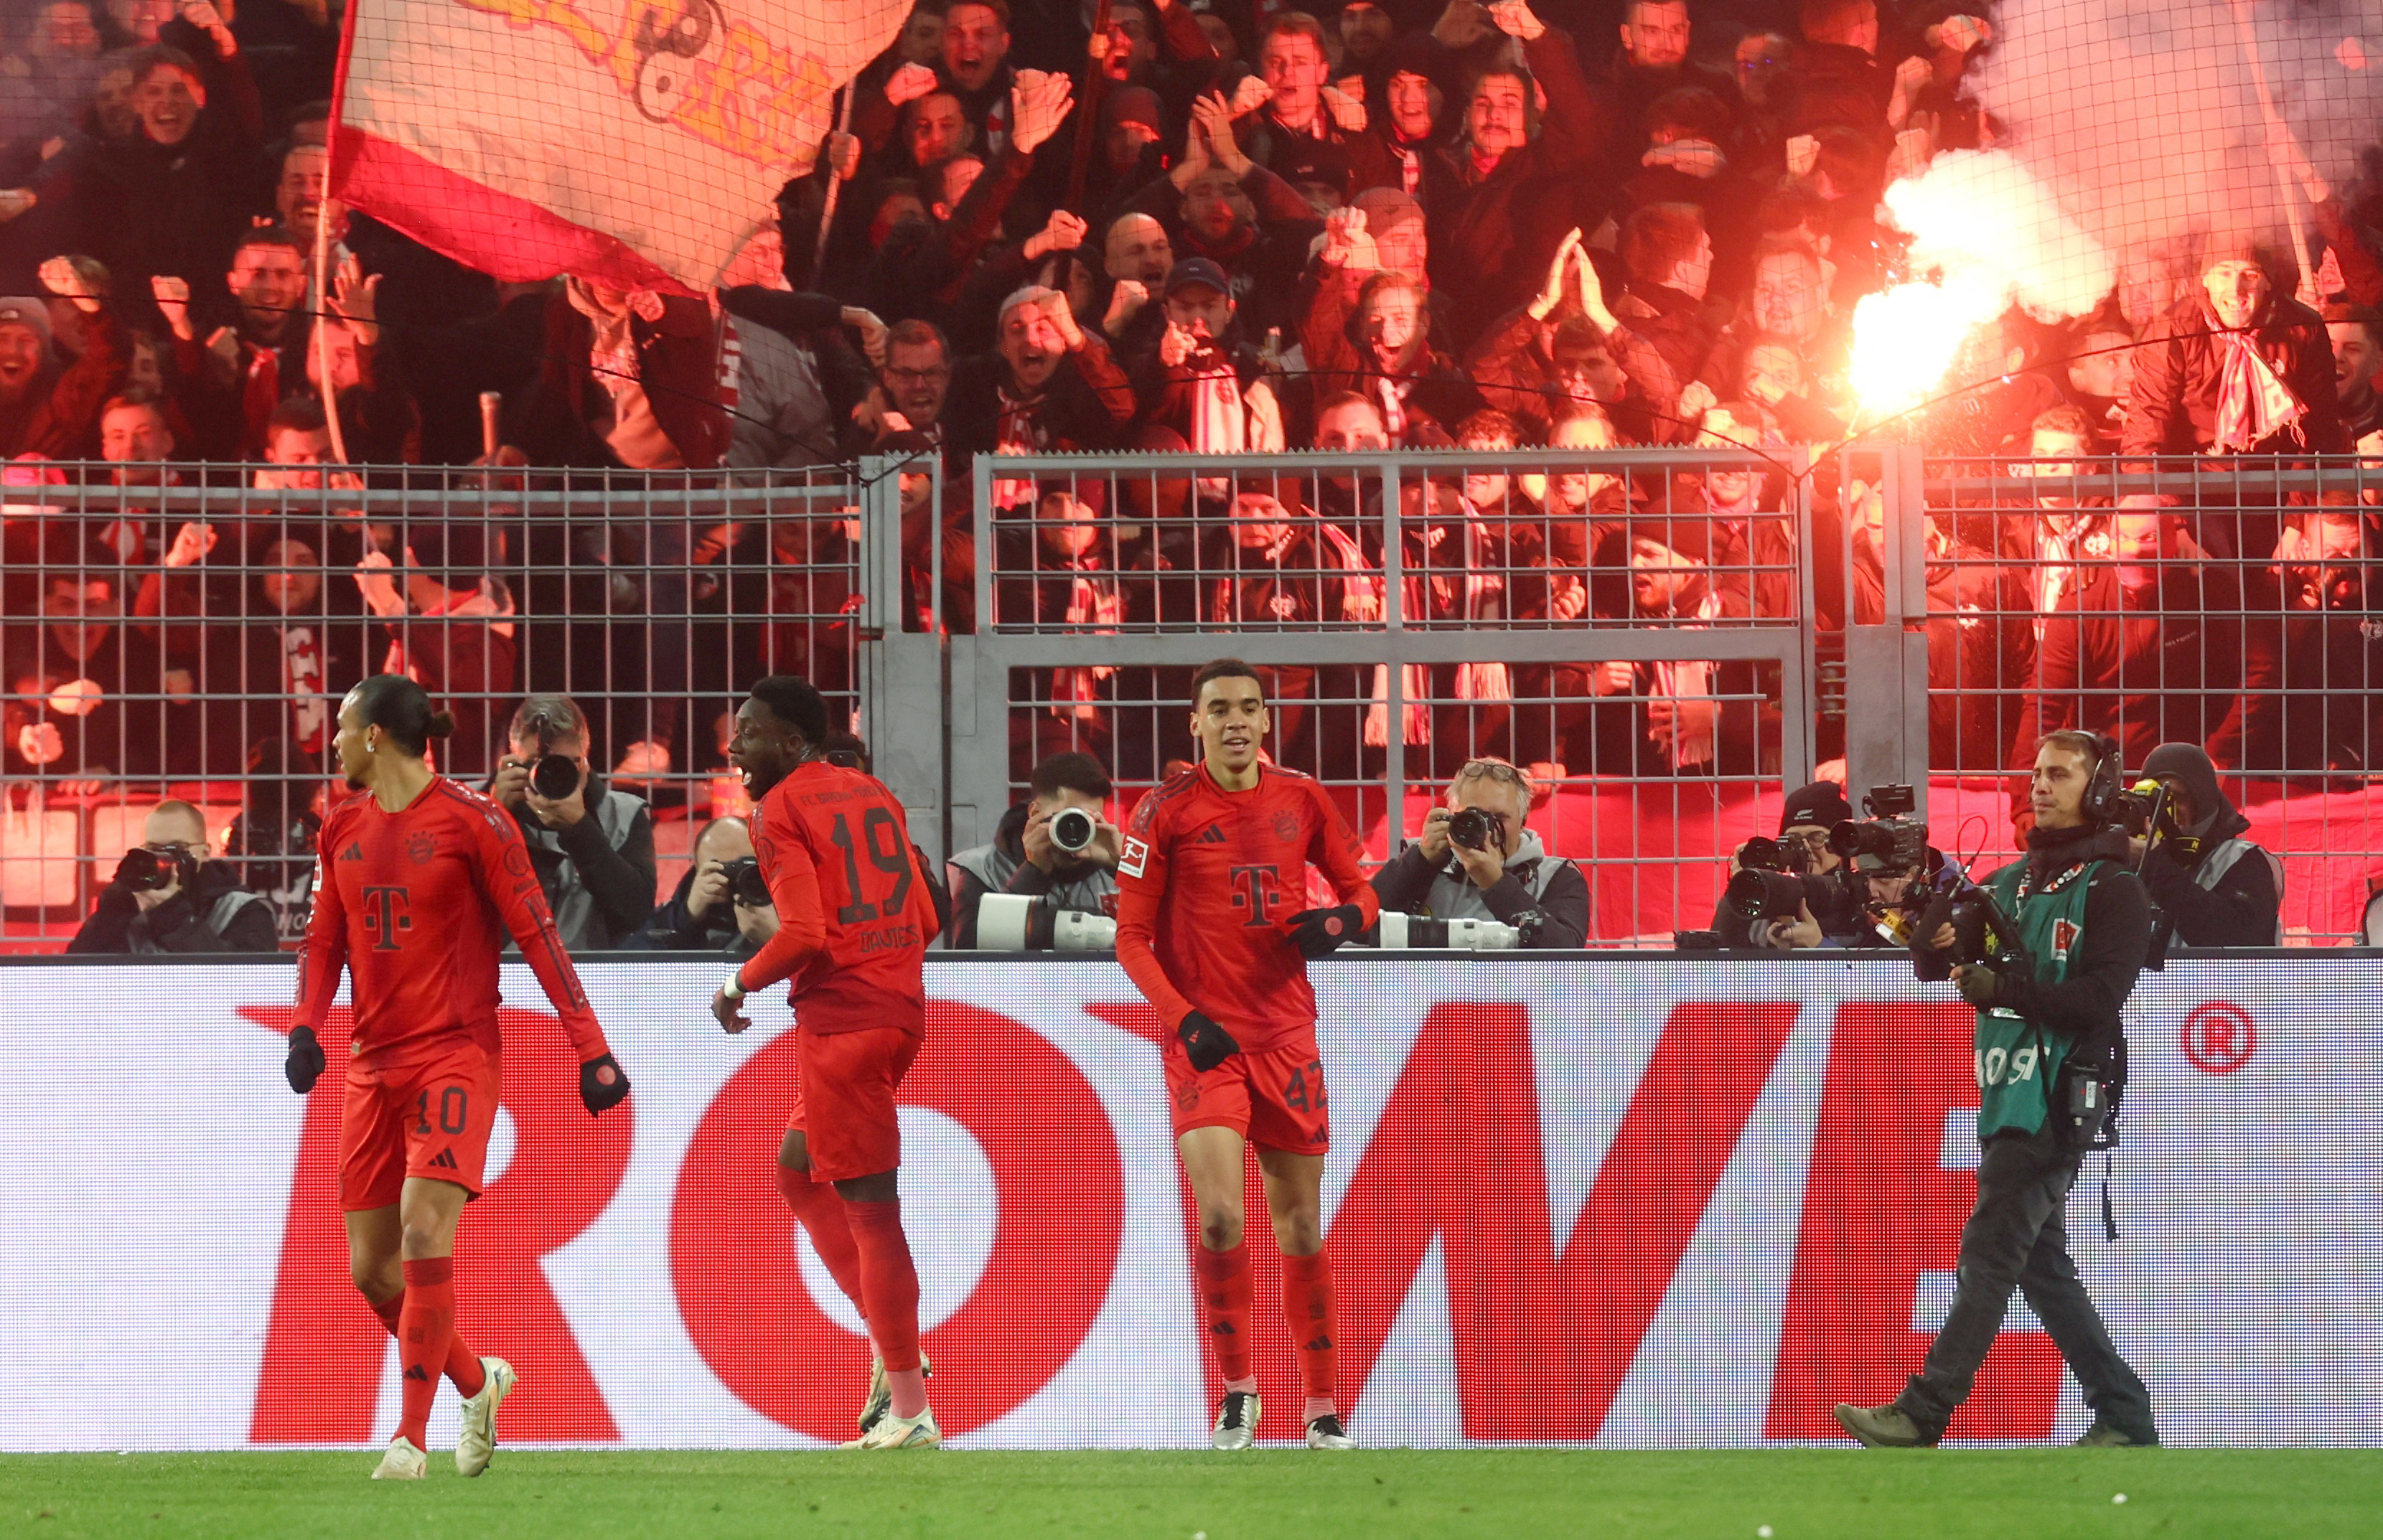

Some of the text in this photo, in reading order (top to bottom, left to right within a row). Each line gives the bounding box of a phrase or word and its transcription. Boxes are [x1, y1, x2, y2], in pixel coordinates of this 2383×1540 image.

[830, 806, 913, 925] 19
[861, 924, 919, 953] DAVIES
[417, 1086, 467, 1135] 10
[1285, 1060, 1328, 1113] 42
[233, 1001, 2064, 1444] ROWE
